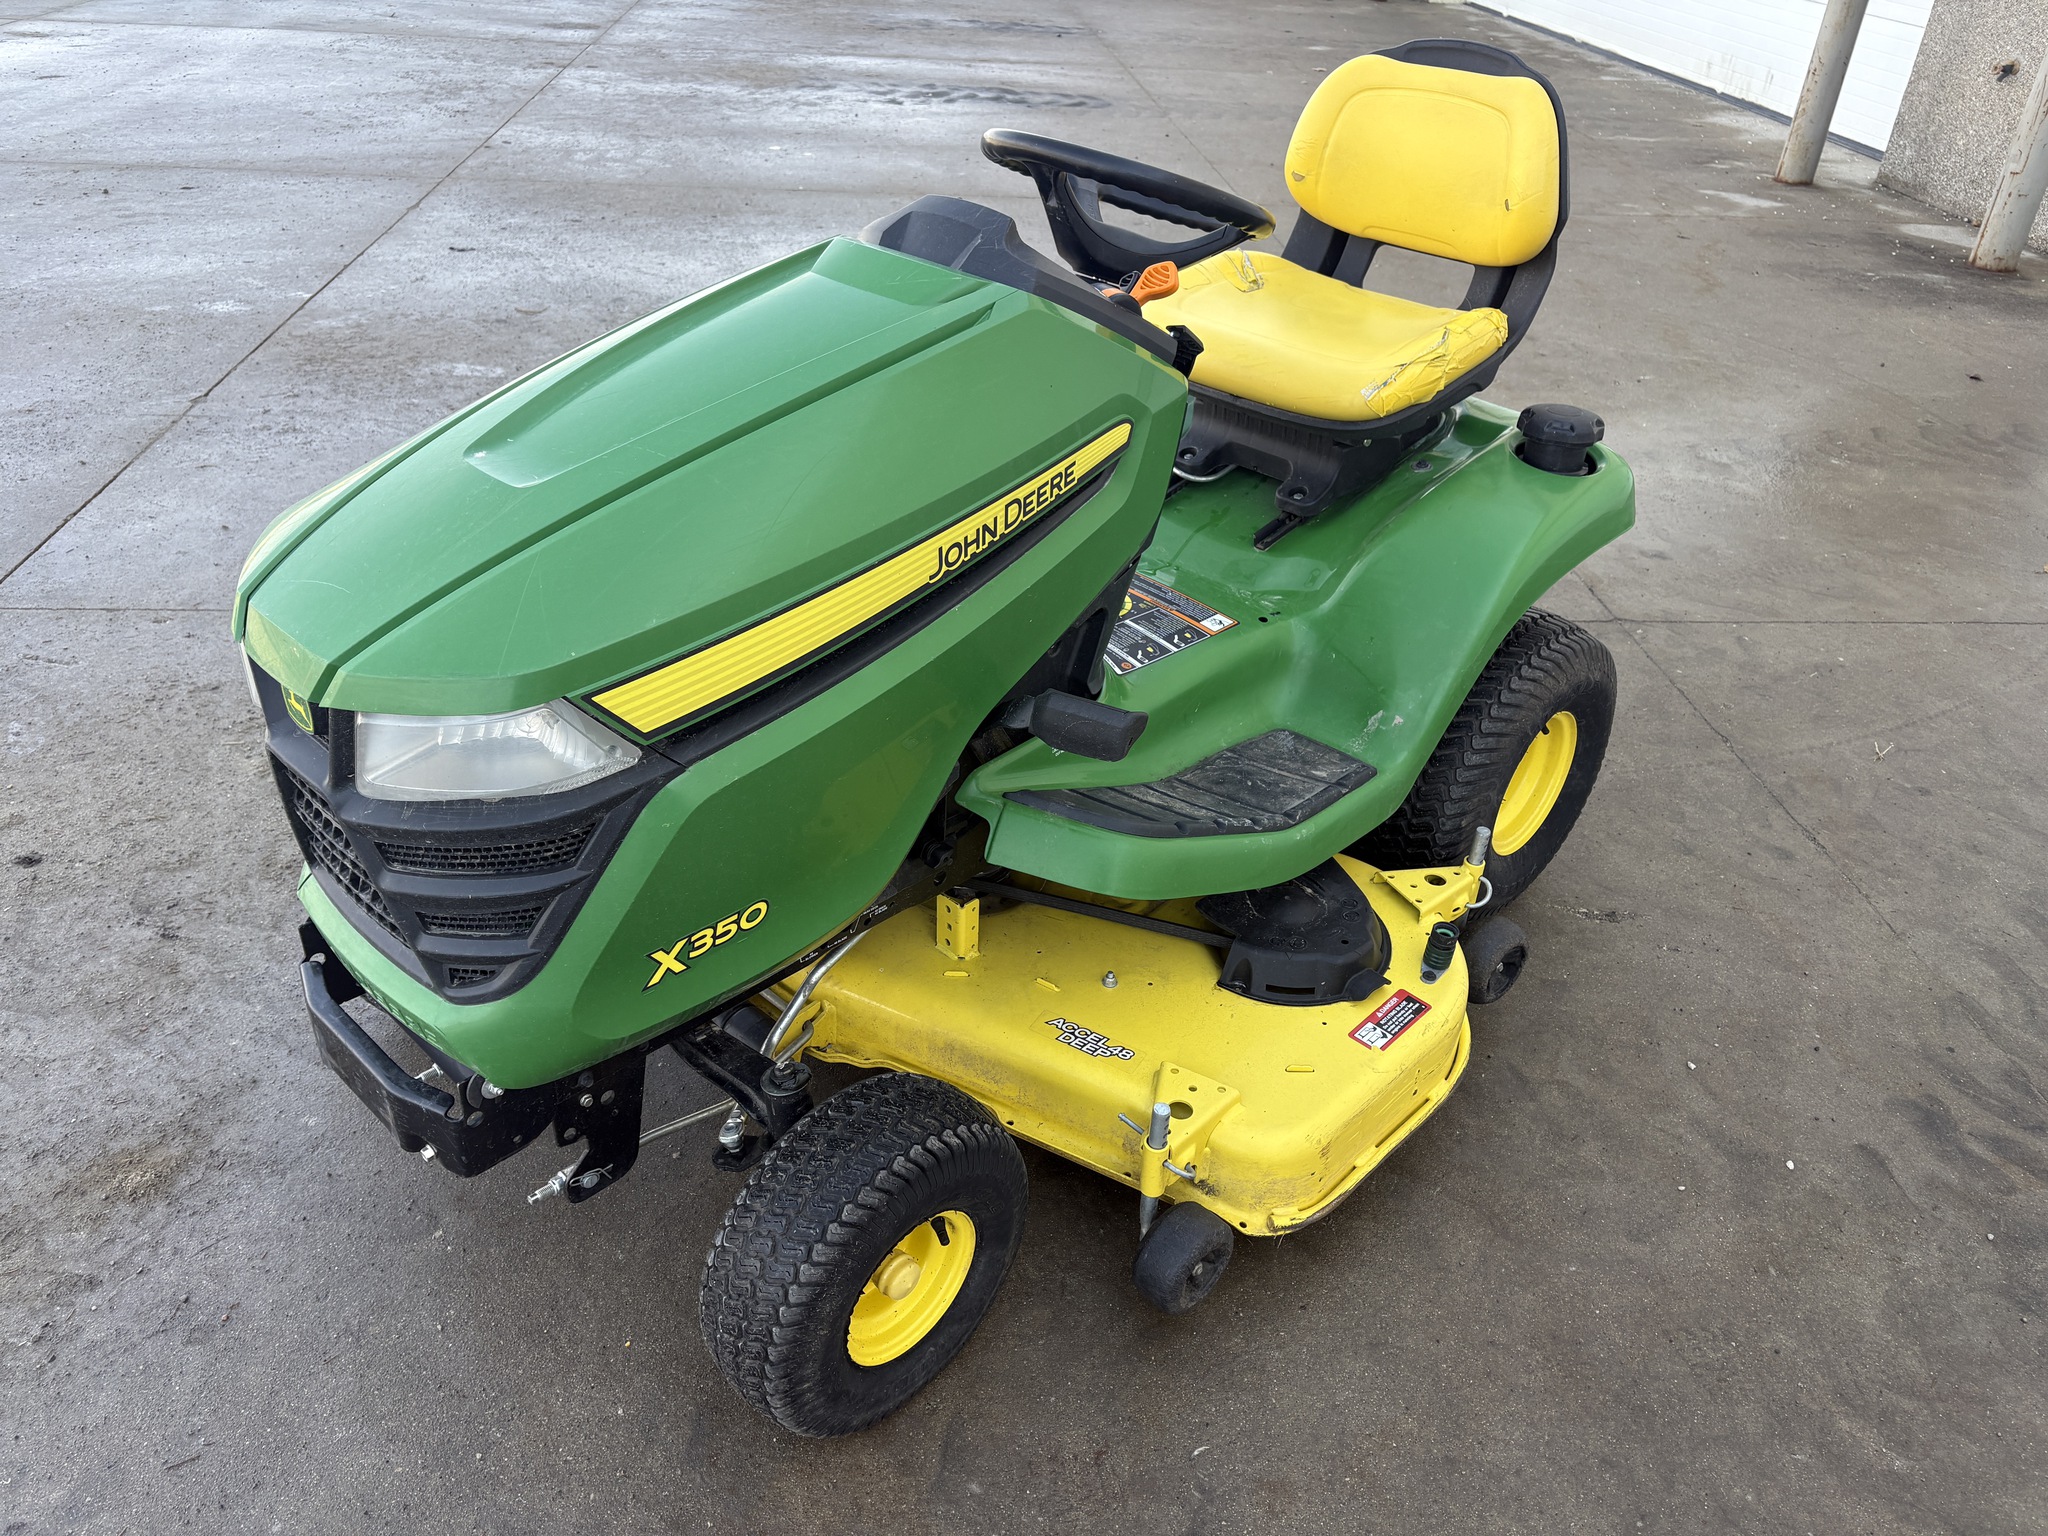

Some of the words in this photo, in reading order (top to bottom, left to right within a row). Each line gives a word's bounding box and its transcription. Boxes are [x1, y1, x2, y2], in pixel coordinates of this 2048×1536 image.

[928, 516, 998, 582] JOHN
[1004, 460, 1077, 531] DEERE
[642, 899, 769, 992] X350
[1379, 997, 1399, 1014] DANGER
[1045, 1018, 1110, 1049] ACCEL
[1108, 1046, 1135, 1060] 48
[1055, 1032, 1112, 1057] DEEP
